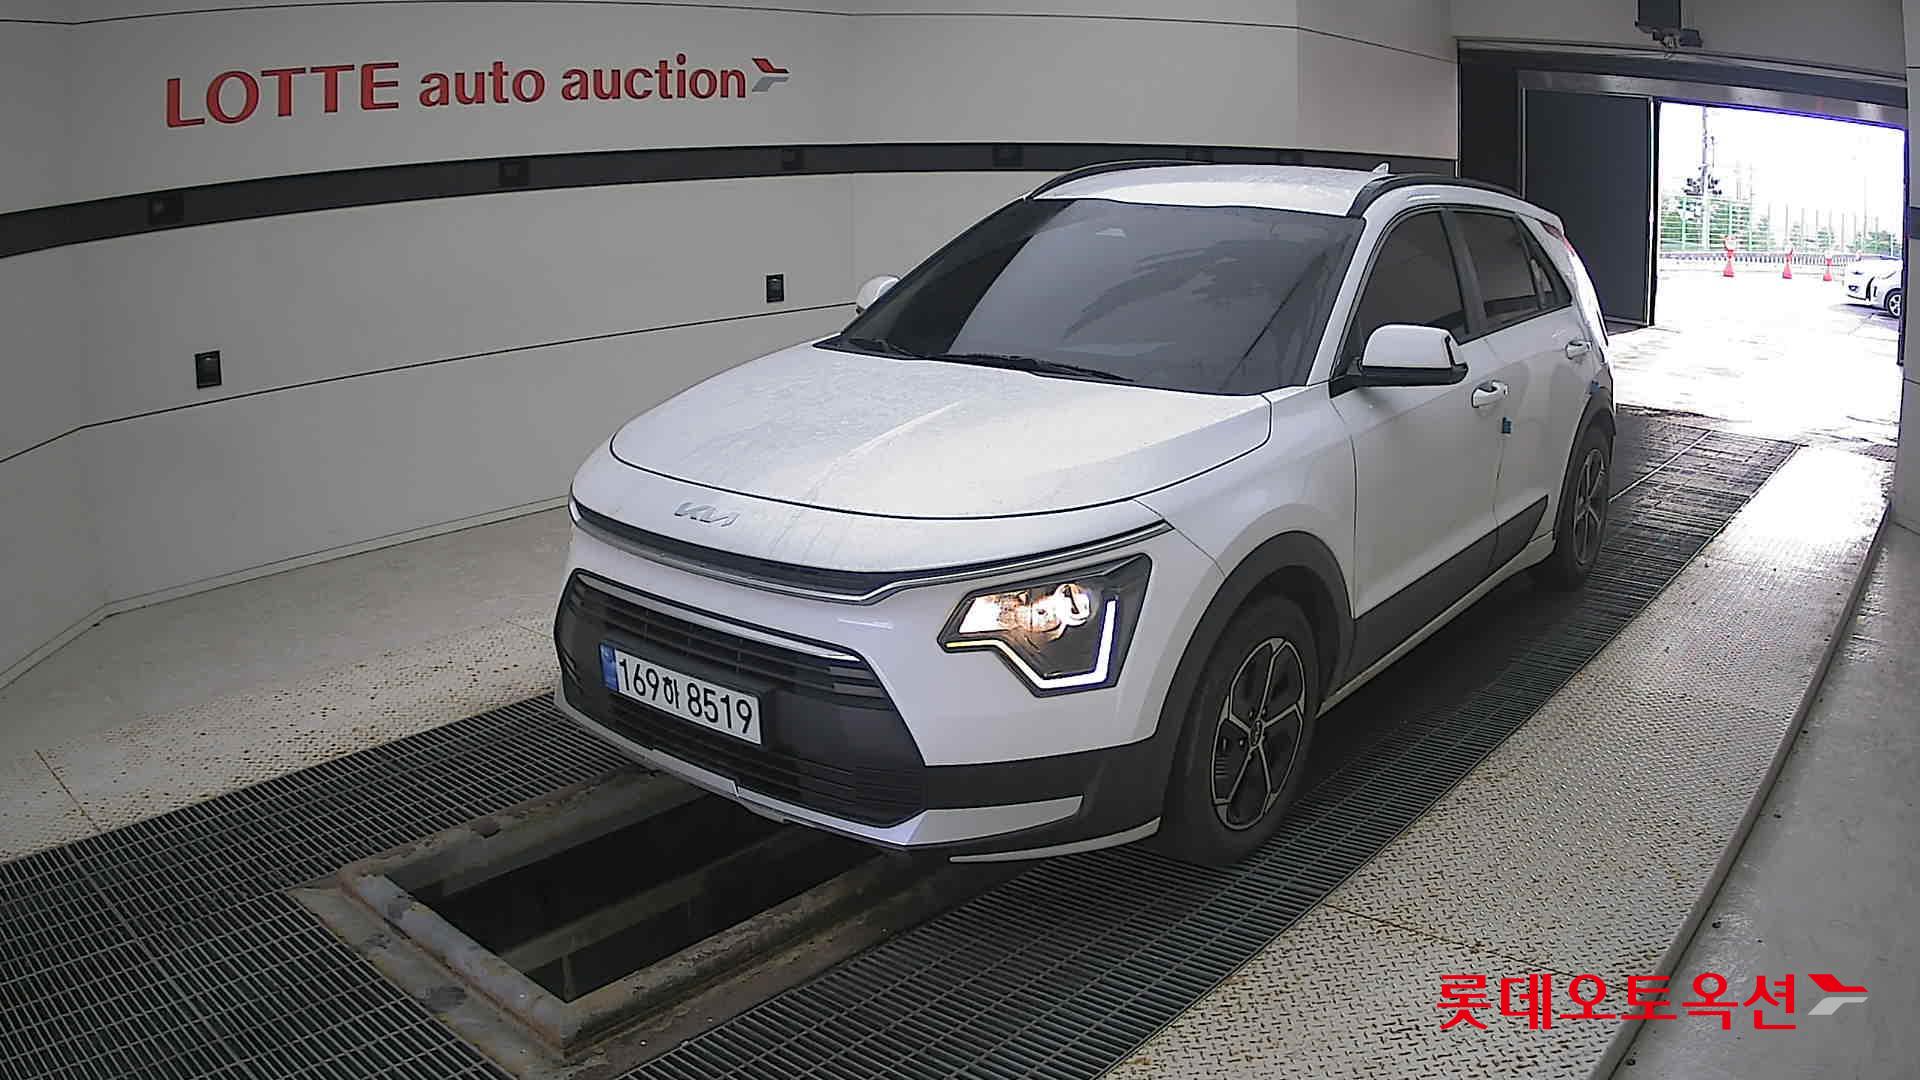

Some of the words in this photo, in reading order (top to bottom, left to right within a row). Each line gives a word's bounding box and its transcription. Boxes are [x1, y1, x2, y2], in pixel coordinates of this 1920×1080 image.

[165, 61, 400, 128] LOTTE
[419, 60, 546, 107] auto
[560, 53, 748, 101] auction
[618, 658, 681, 710] 169하
[686, 682, 753, 735] 8519
